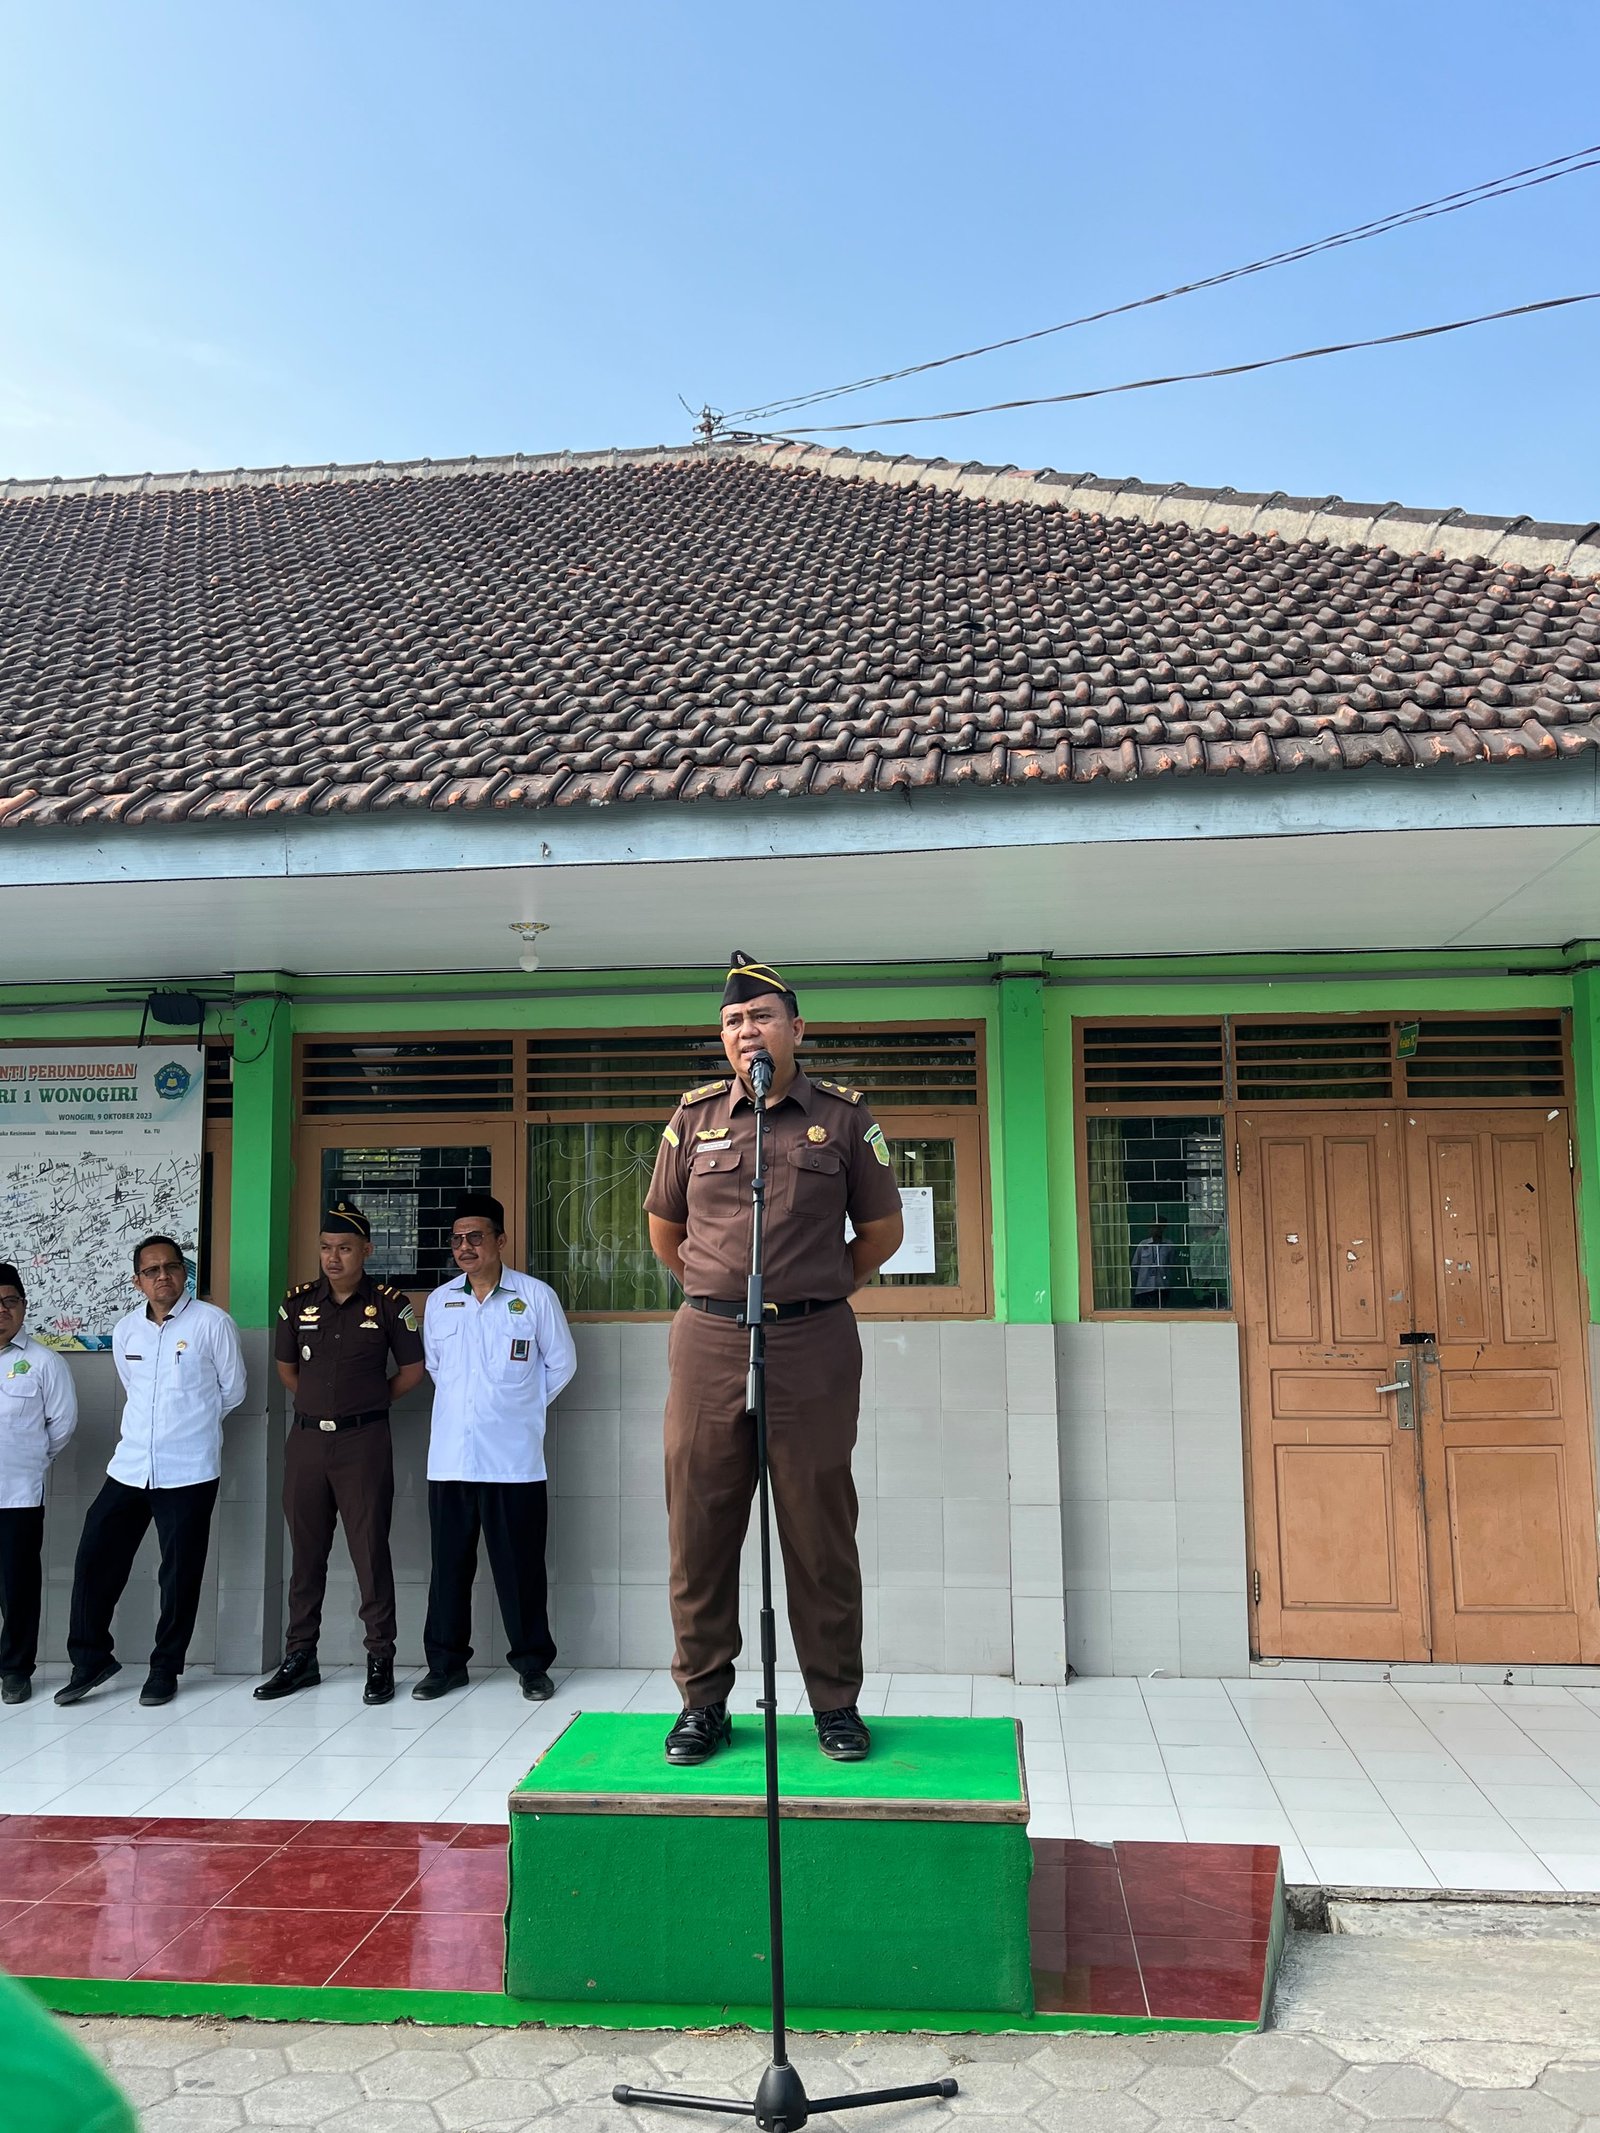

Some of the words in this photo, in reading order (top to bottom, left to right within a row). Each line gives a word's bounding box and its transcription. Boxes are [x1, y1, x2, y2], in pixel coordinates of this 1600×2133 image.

[28, 1063, 136, 1080] PERUNDUNGAN
[24, 1090, 31, 1103] 1
[38, 1087, 139, 1103] WONOGIRI
[58, 1113, 96, 1121] WONOGIRI,
[136, 1112, 153, 1120] 2023
